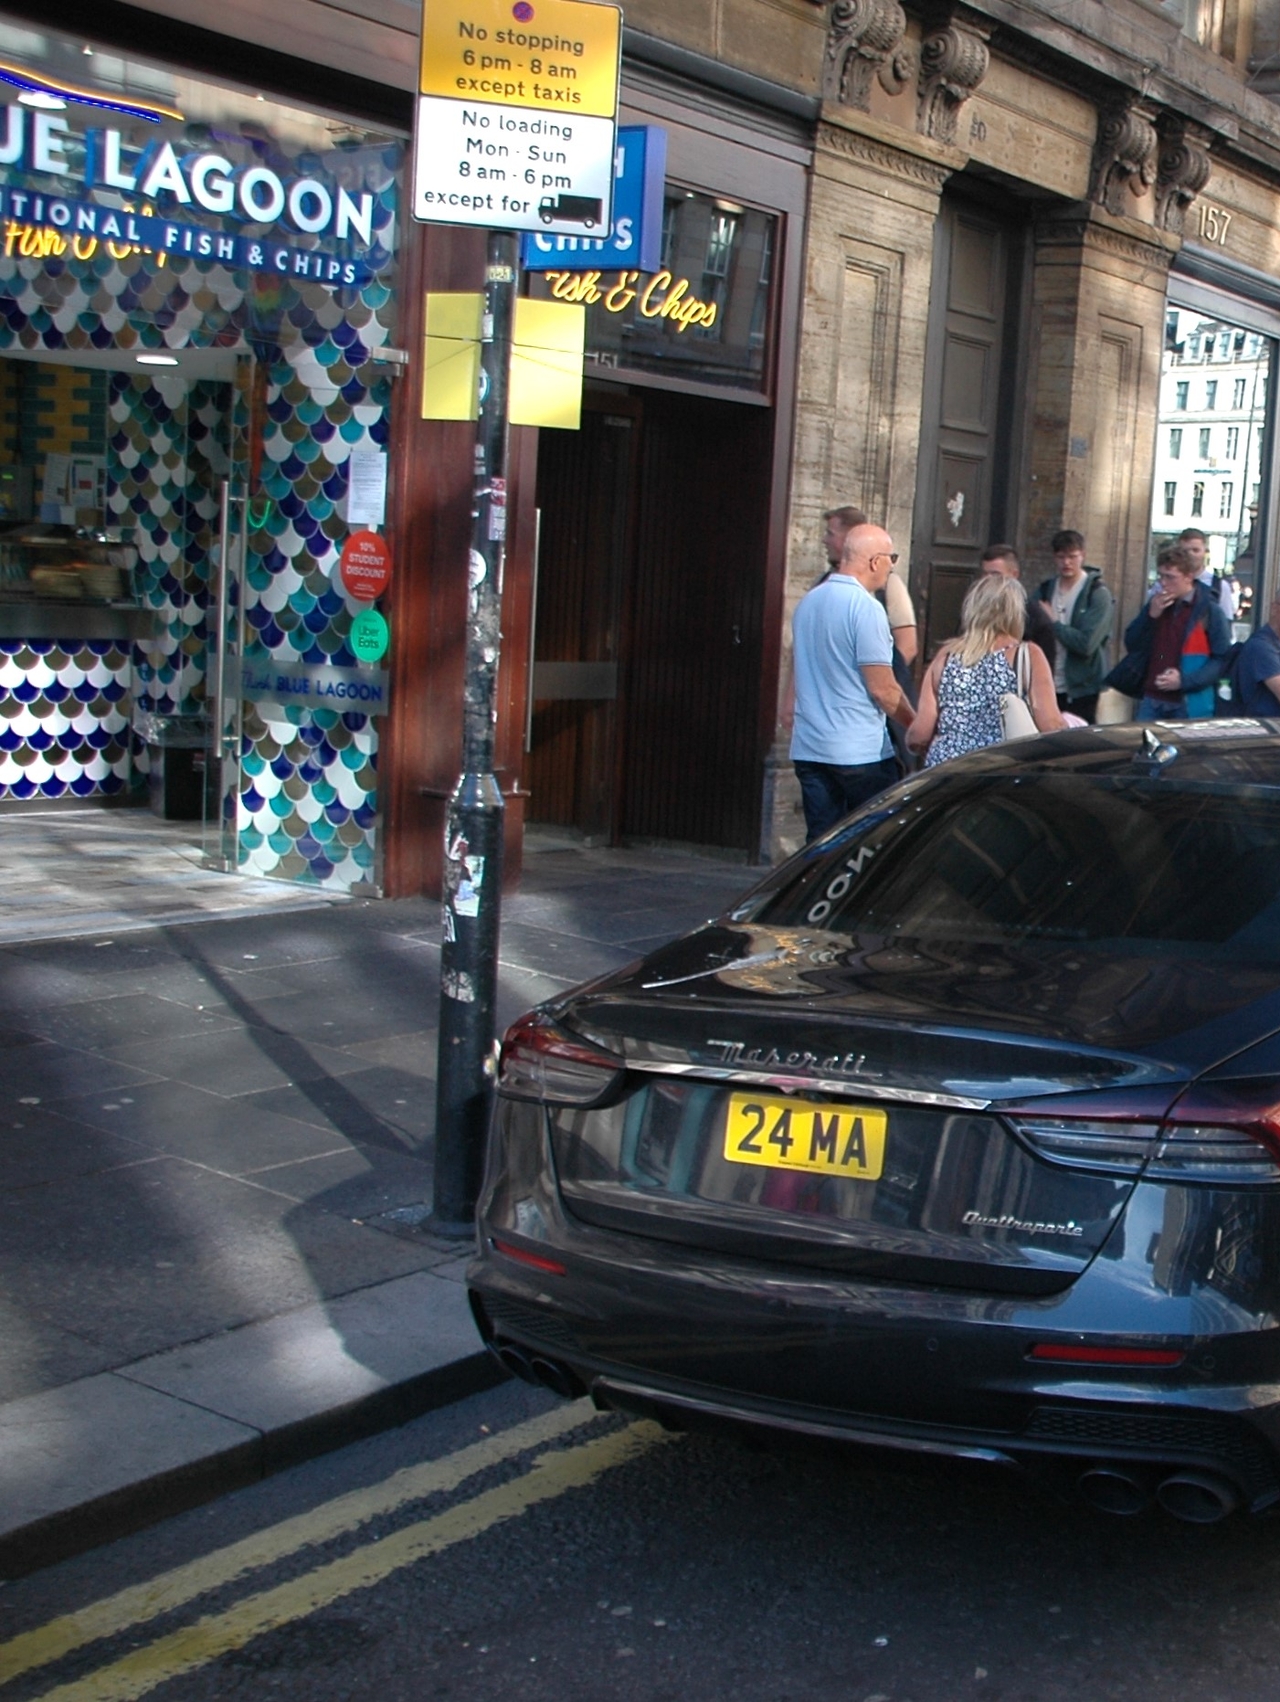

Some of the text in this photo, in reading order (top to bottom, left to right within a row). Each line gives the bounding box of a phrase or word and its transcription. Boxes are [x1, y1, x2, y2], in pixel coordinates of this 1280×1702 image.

[459, 21, 585, 57] No stopping
[463, 49, 475, 66] 6
[480, 55, 512, 71] pm
[530, 58, 542, 75] 8
[547, 64, 577, 79] am
[456, 76, 582, 104] except taxis
[462, 109, 573, 142] No loading
[466, 137, 509, 157] Mon
[527, 144, 567, 164] Sun
[103, 129, 374, 247] LAGOON
[459, 160, 471, 177] 8
[476, 166, 506, 181] am
[524, 168, 536, 185] 6
[541, 173, 572, 189] pm
[424, 190, 531, 213] except for
[0, 191, 141, 242] TIONAL
[164, 226, 234, 260] FISH
[248, 244, 264, 266] &
[275, 249, 356, 285] CHIPS
[1199, 205, 1232, 246] 157
[545, 270, 602, 305] ish
[641, 271, 717, 332] Chips
[346, 565, 386, 579] DISCOUNT
[348, 553, 385, 566] STUDENT
[358, 637, 380, 649] Eats
[359, 625, 380, 637] Uber
[276, 676, 311, 695] BLUE
[316, 680, 382, 702] LAGOON
[706, 1038, 884, 1078] Maserati
[737, 1103, 868, 1169] 24 MA
[961, 1210, 1084, 1237] Quattroporte
